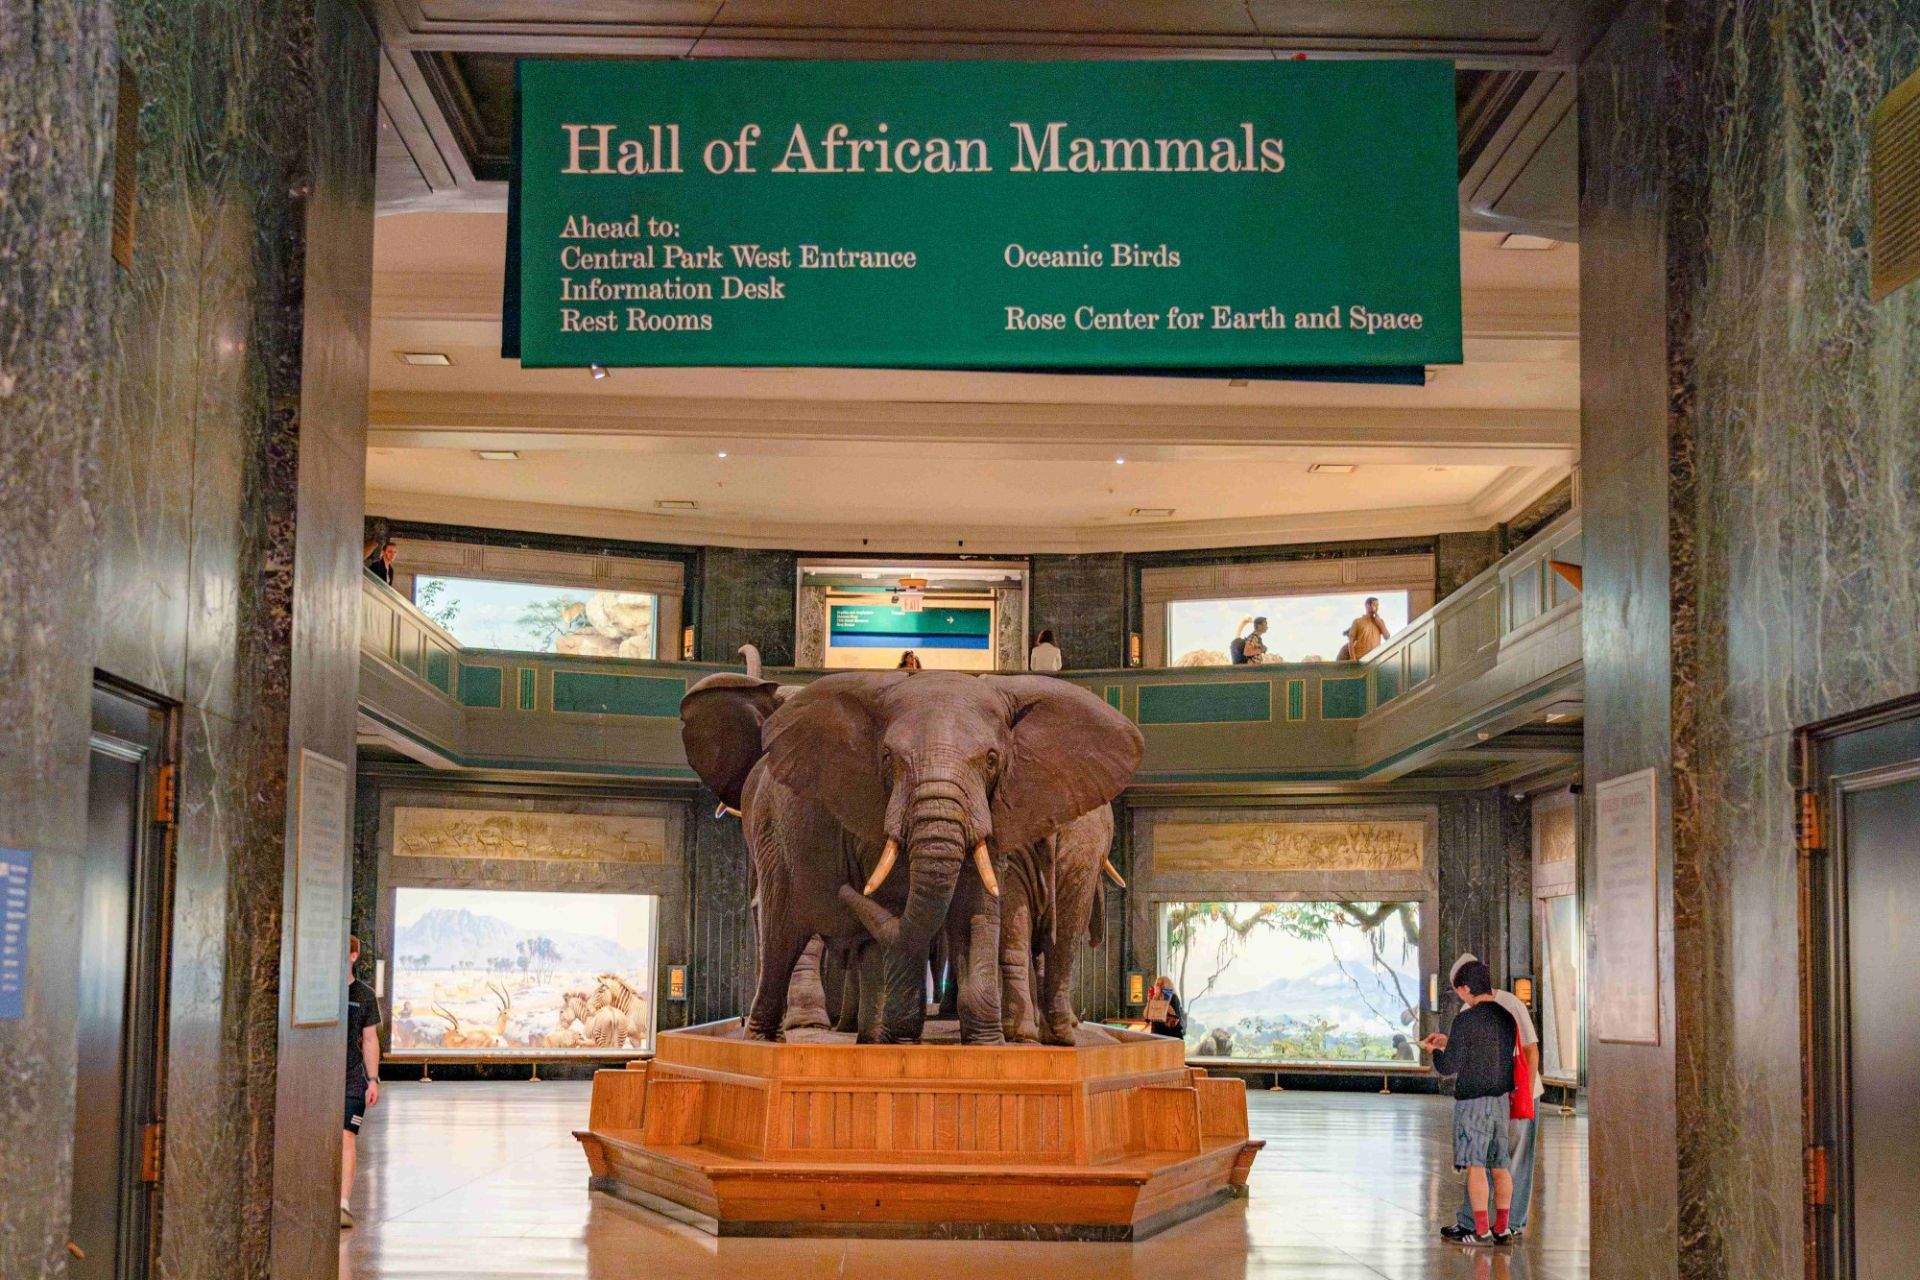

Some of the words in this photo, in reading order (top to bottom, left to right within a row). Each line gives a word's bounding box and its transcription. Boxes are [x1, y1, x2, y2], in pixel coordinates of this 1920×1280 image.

[561, 124, 683, 175] Hall
[704, 123, 761, 175] of
[771, 122, 992, 174] African
[1010, 122, 1285, 173] Mammals
[560, 214, 640, 239] Ahead
[648, 216, 680, 238] to:
[560, 244, 655, 270] Central
[662, 244, 724, 269] Park
[730, 244, 791, 269] West
[799, 244, 917, 269] Entrance
[1003, 244, 1103, 268] Oceanic
[1111, 243, 1181, 268] Birds
[560, 276, 713, 301] Information
[721, 275, 786, 300] Desk
[560, 308, 618, 332] Rest
[626, 307, 713, 332] Rooms
[1004, 306, 1066, 331] Rose
[1074, 306, 1159, 331] Center
[1166, 306, 1204, 330] for
[1211, 305, 1286, 330] Earth
[1294, 305, 1341, 329] and
[1349, 305, 1423, 335] Space
